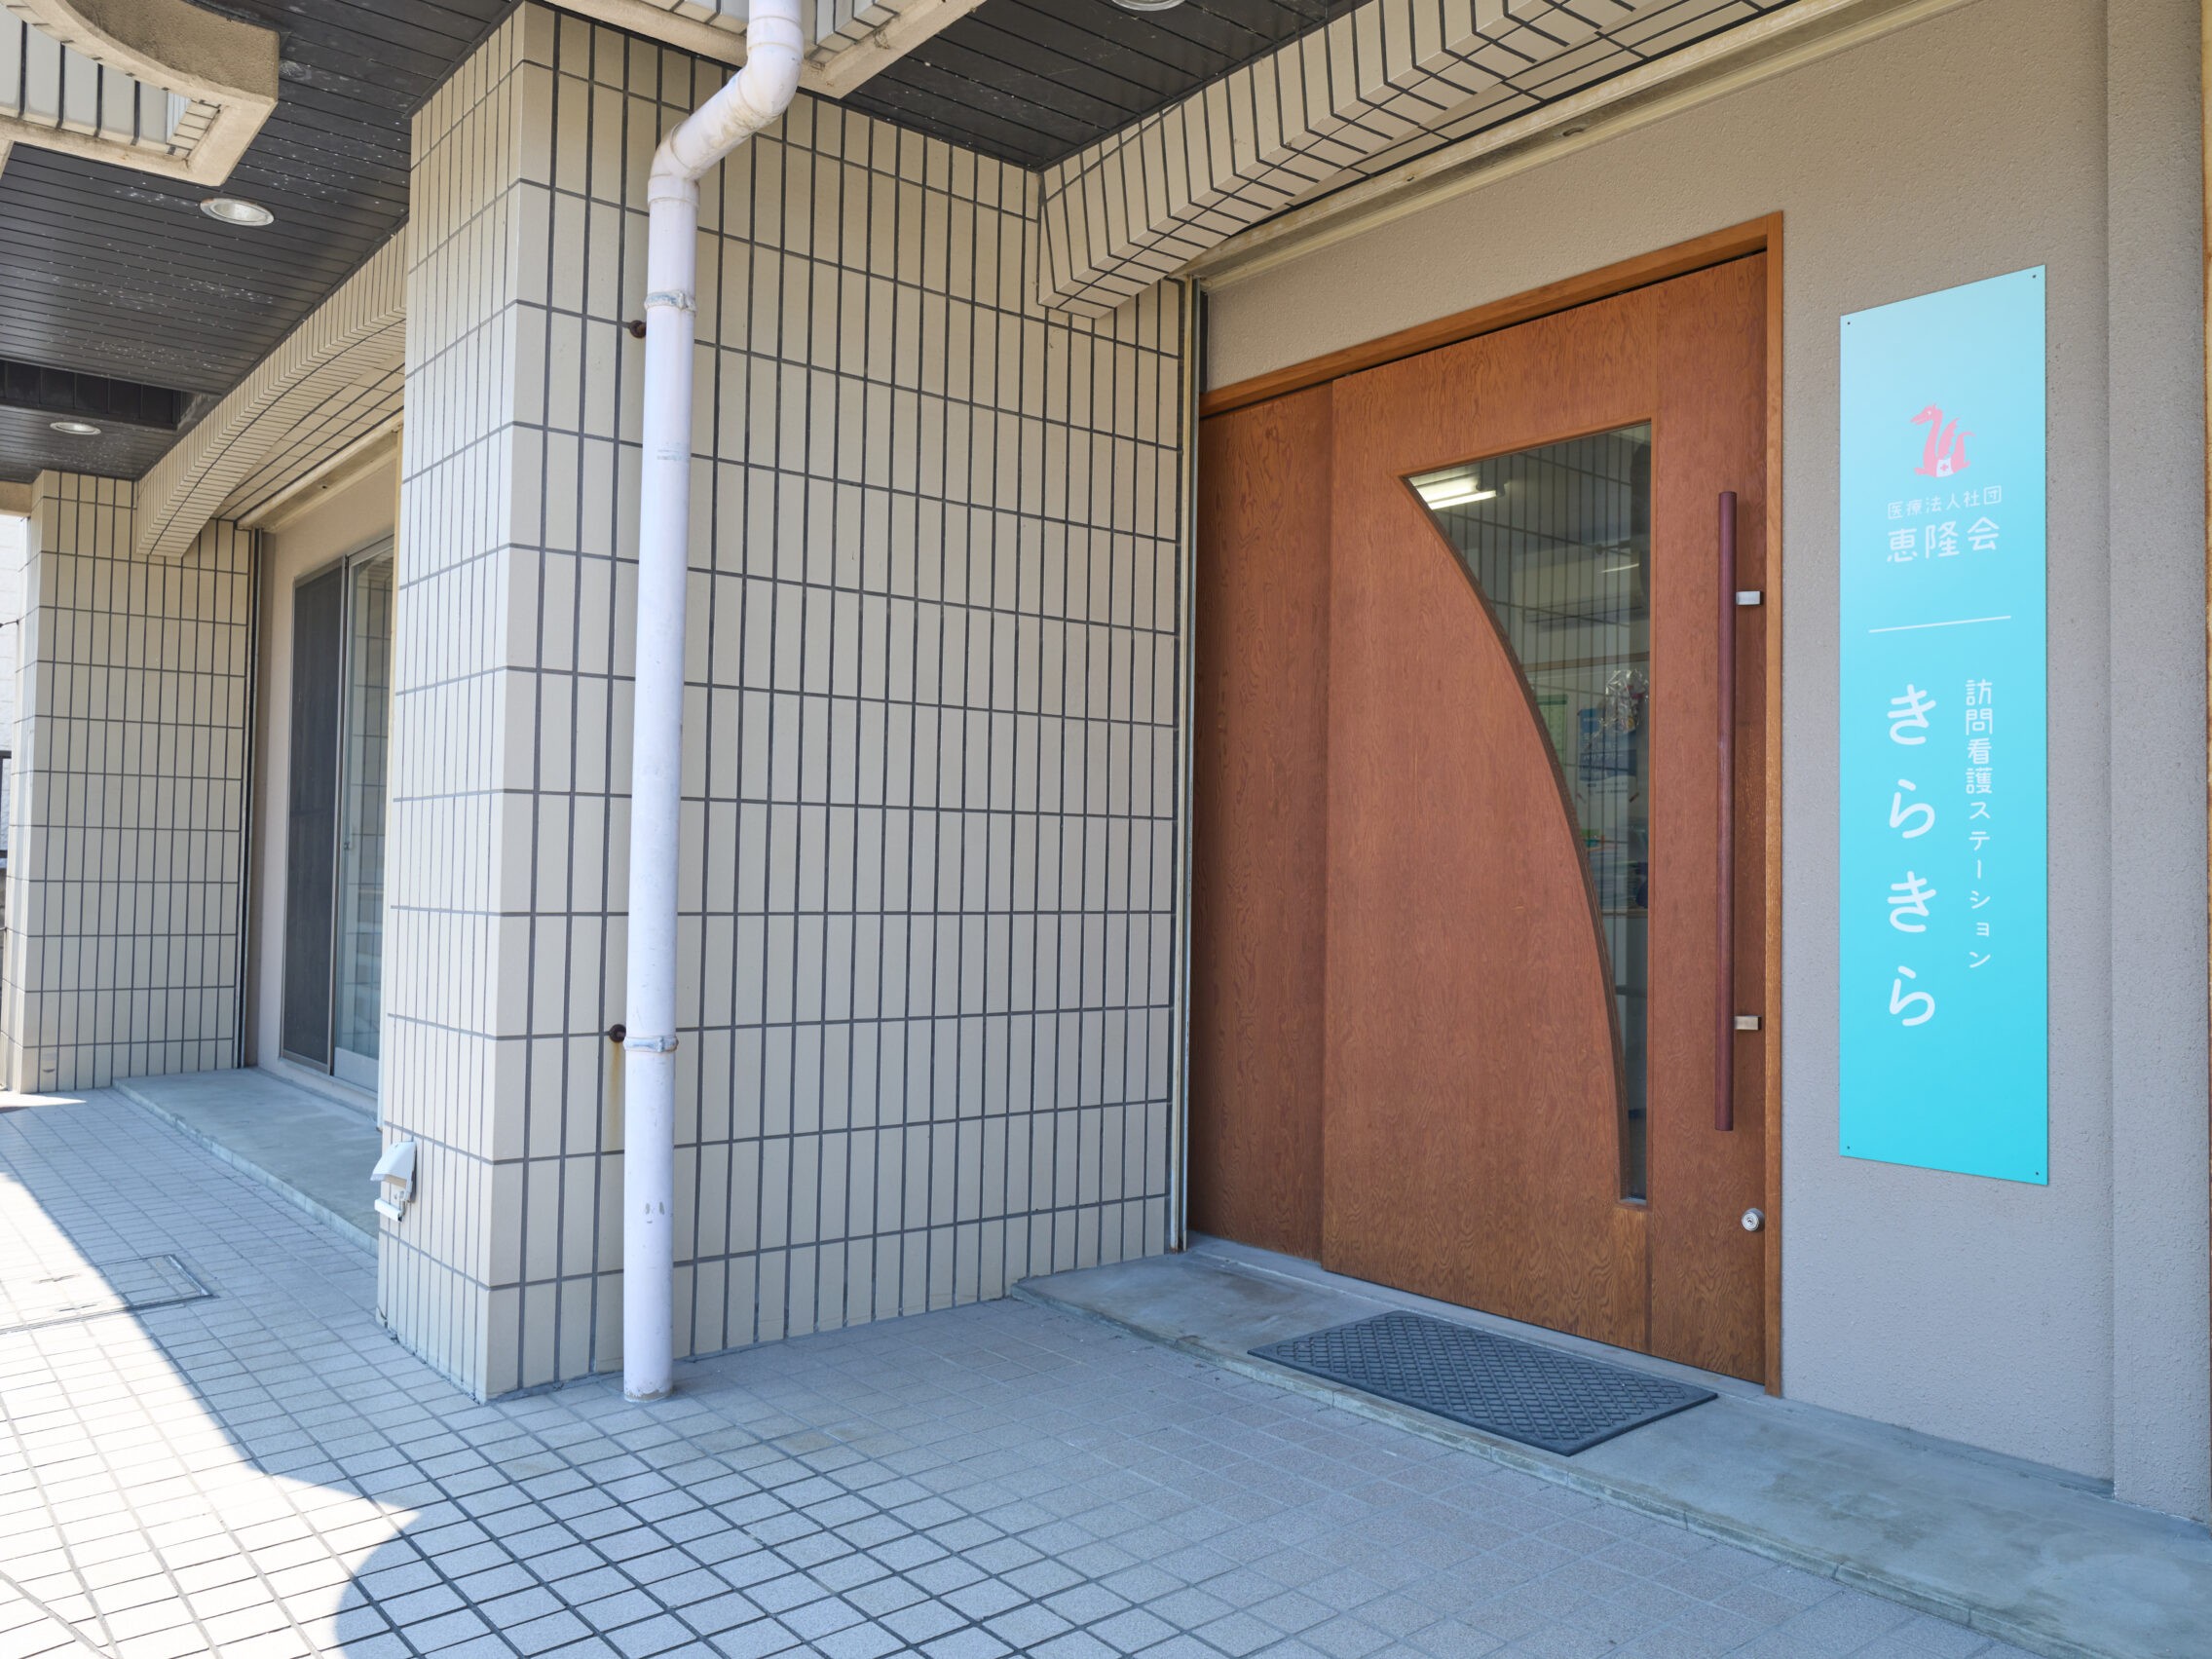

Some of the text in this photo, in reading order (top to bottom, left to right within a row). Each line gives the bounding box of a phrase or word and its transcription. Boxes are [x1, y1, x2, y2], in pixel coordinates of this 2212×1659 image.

[1887, 485, 2003, 517] 医療法人社団
[1887, 516, 2000, 562] 恵隆会
[1887, 684, 1937, 1028] きらきら
[1965, 678, 1994, 969] 訪問看護ステーション
